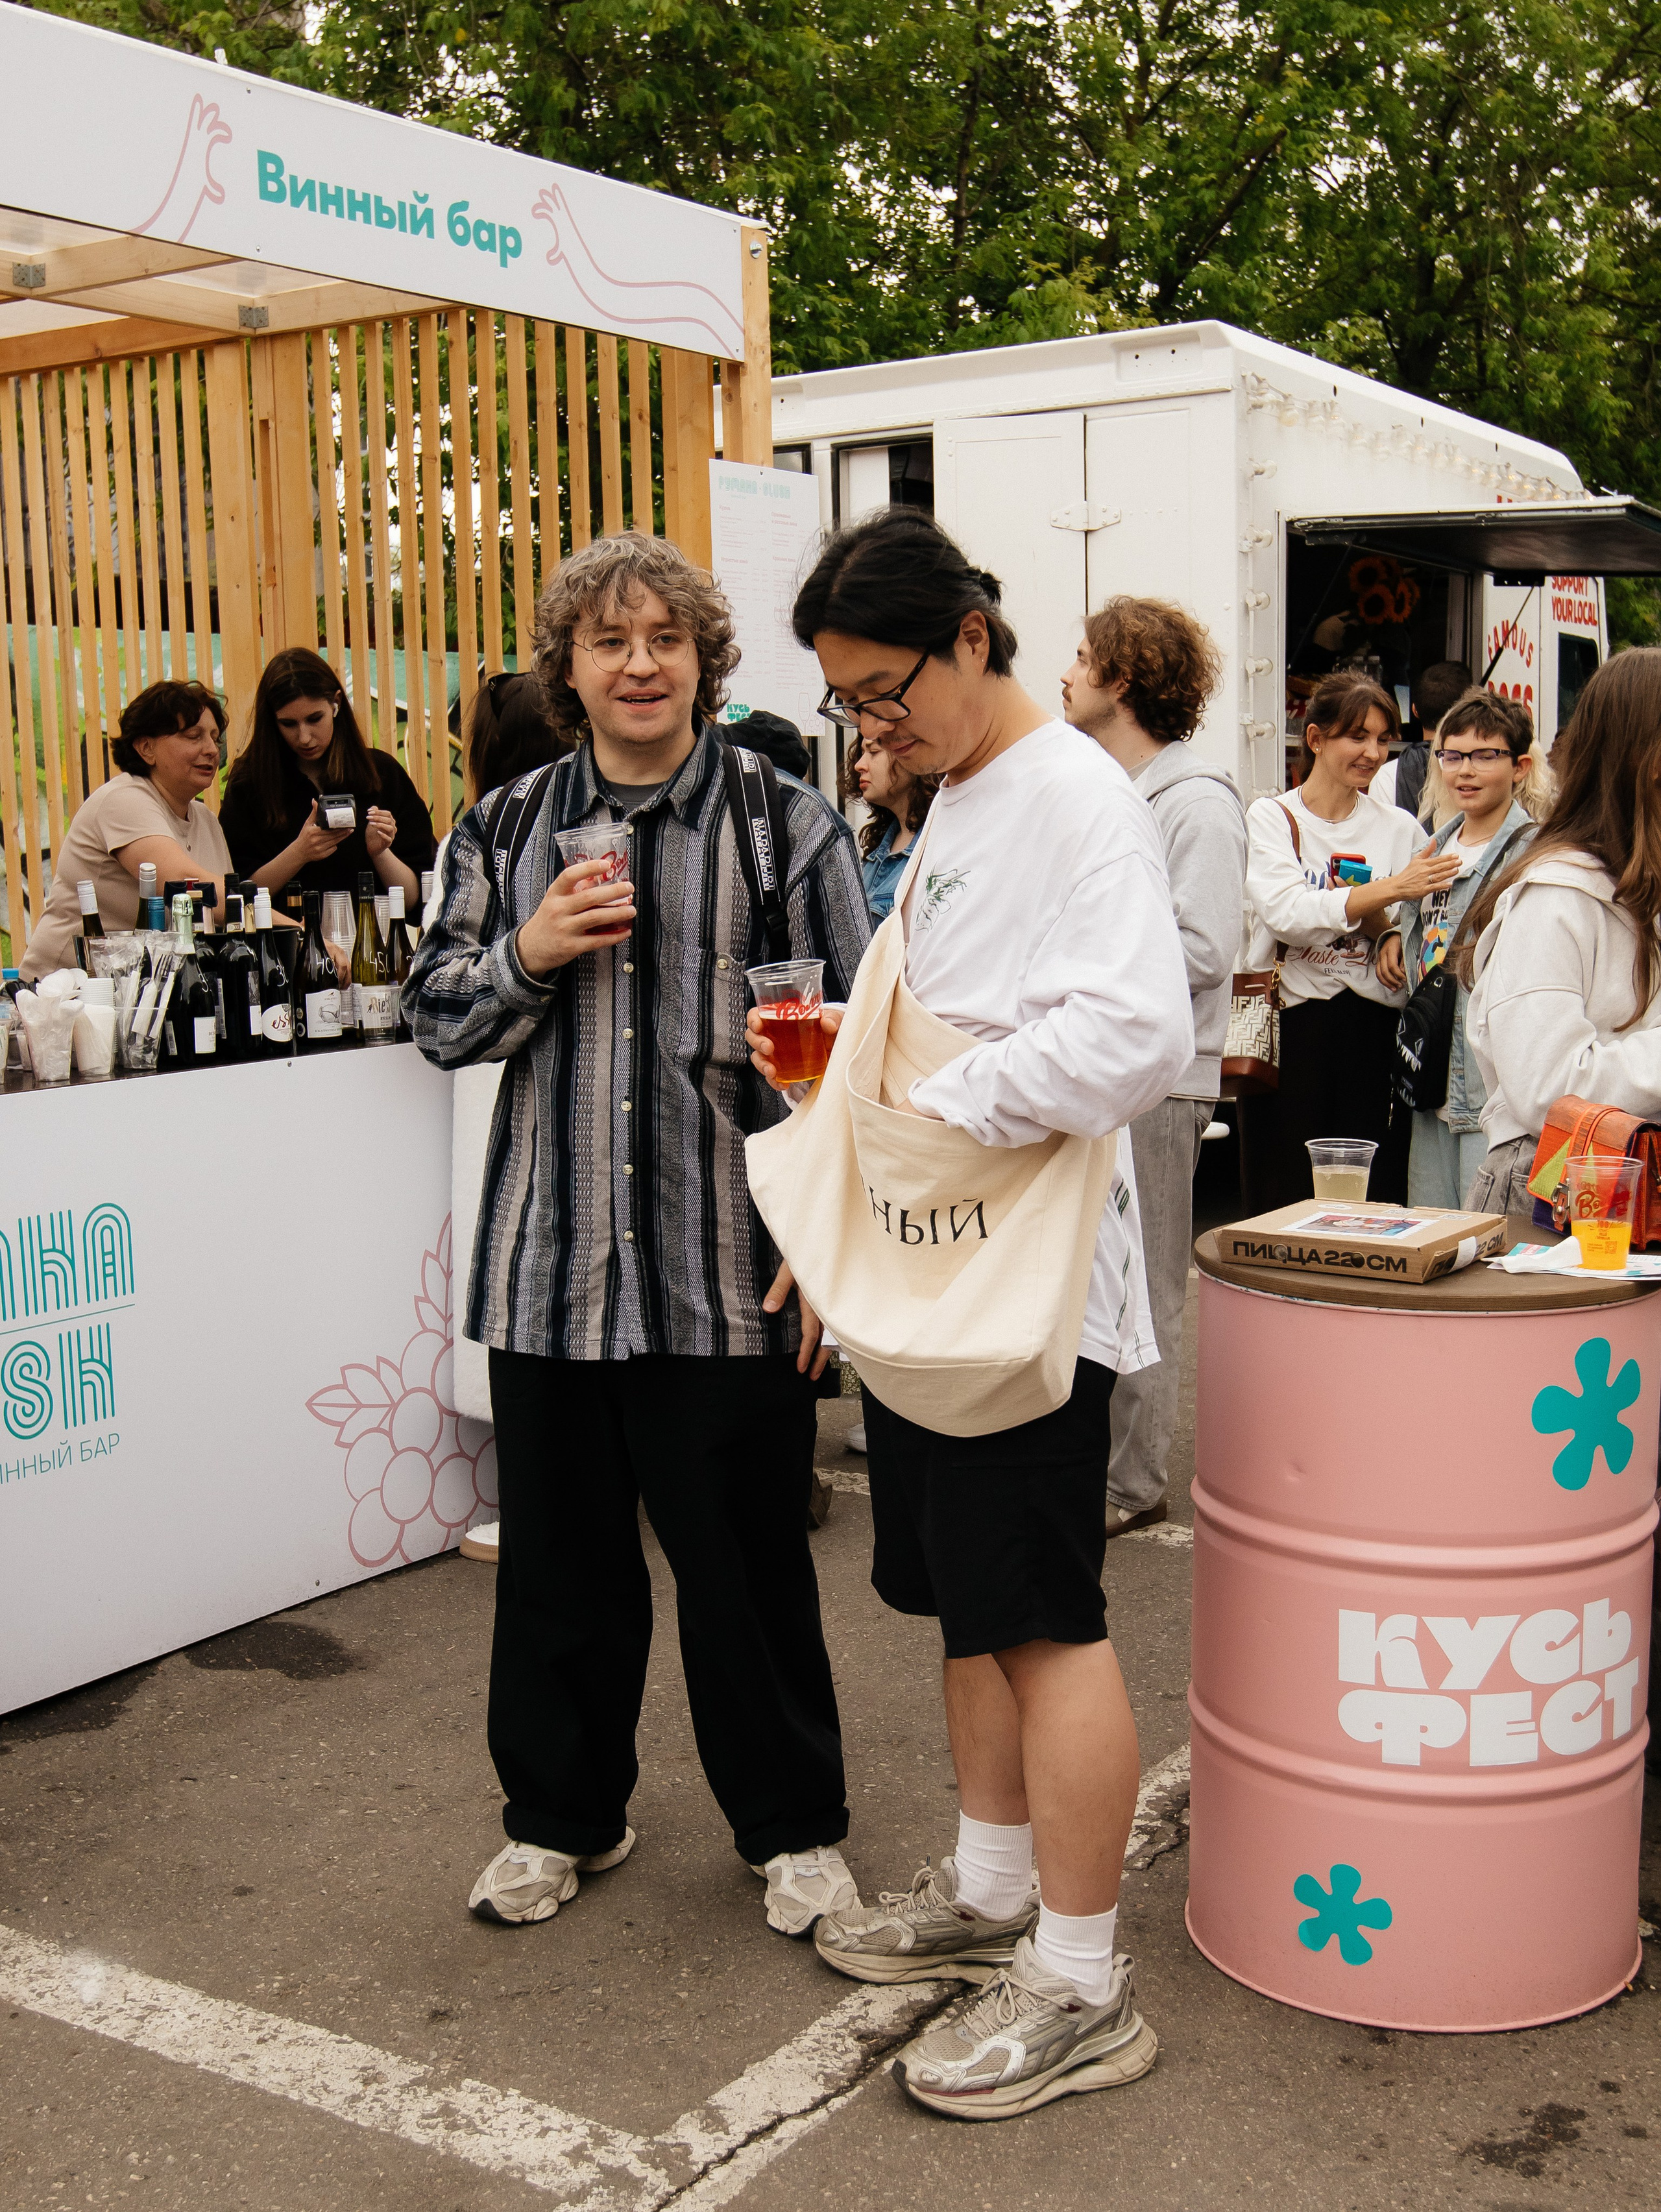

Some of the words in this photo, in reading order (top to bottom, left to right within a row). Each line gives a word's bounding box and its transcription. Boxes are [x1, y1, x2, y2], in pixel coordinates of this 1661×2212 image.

[257, 149, 435, 239] Винный
[446, 200, 522, 269] бар
[1551, 577, 1589, 597] SUPPORT
[1551, 595, 1573, 622] YOUR
[1573, 601, 1597, 626] LOCAL
[727, 704, 750, 713] КУСЬ
[861, 1175, 988, 1245] НЫЙ
[1366, 1255, 1407, 1273] СМ
[0, 1439, 73, 1484] ННЫЙ
[80, 1432, 121, 1463] БАР
[1338, 1597, 1632, 1690] КУСЬ
[1337, 1655, 1639, 1767] ФЕСТ
